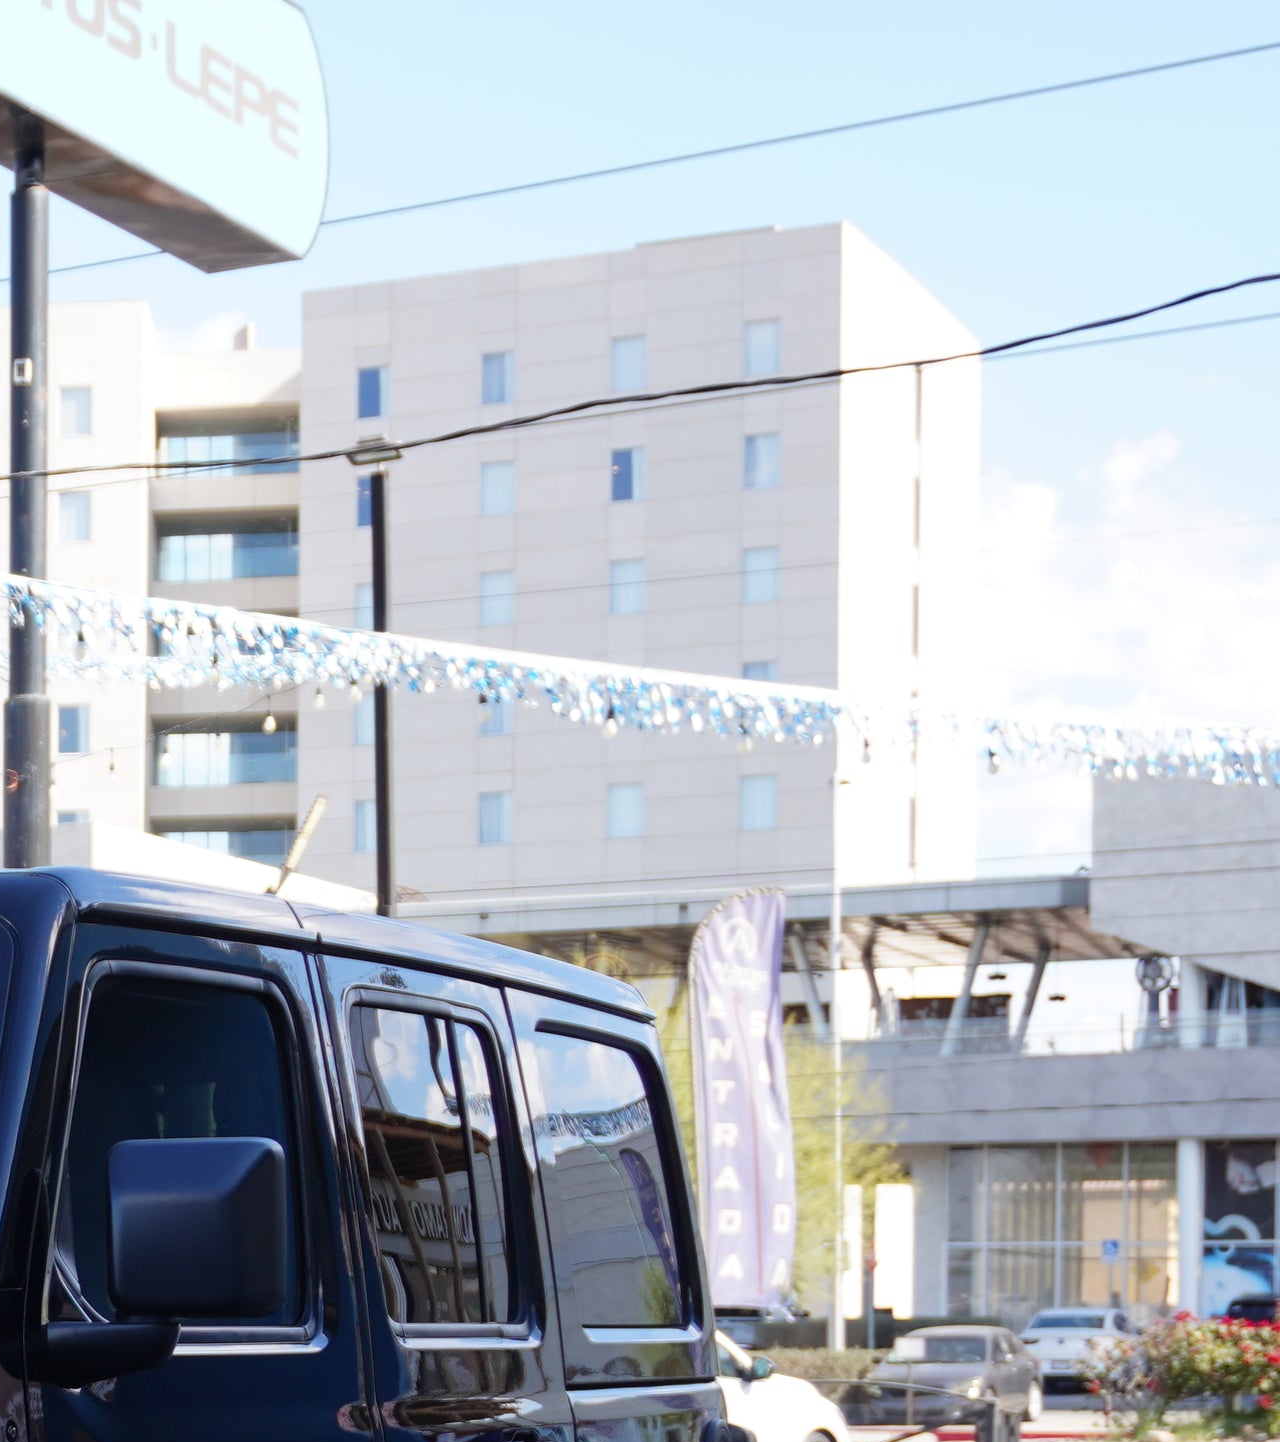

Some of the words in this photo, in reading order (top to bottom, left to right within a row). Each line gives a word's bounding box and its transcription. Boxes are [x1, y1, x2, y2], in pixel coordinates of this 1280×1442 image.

[165, 19, 299, 159] LEPE
[706, 994, 743, 1281] ENTRADA
[749, 1010, 792, 1288] SALIDA
